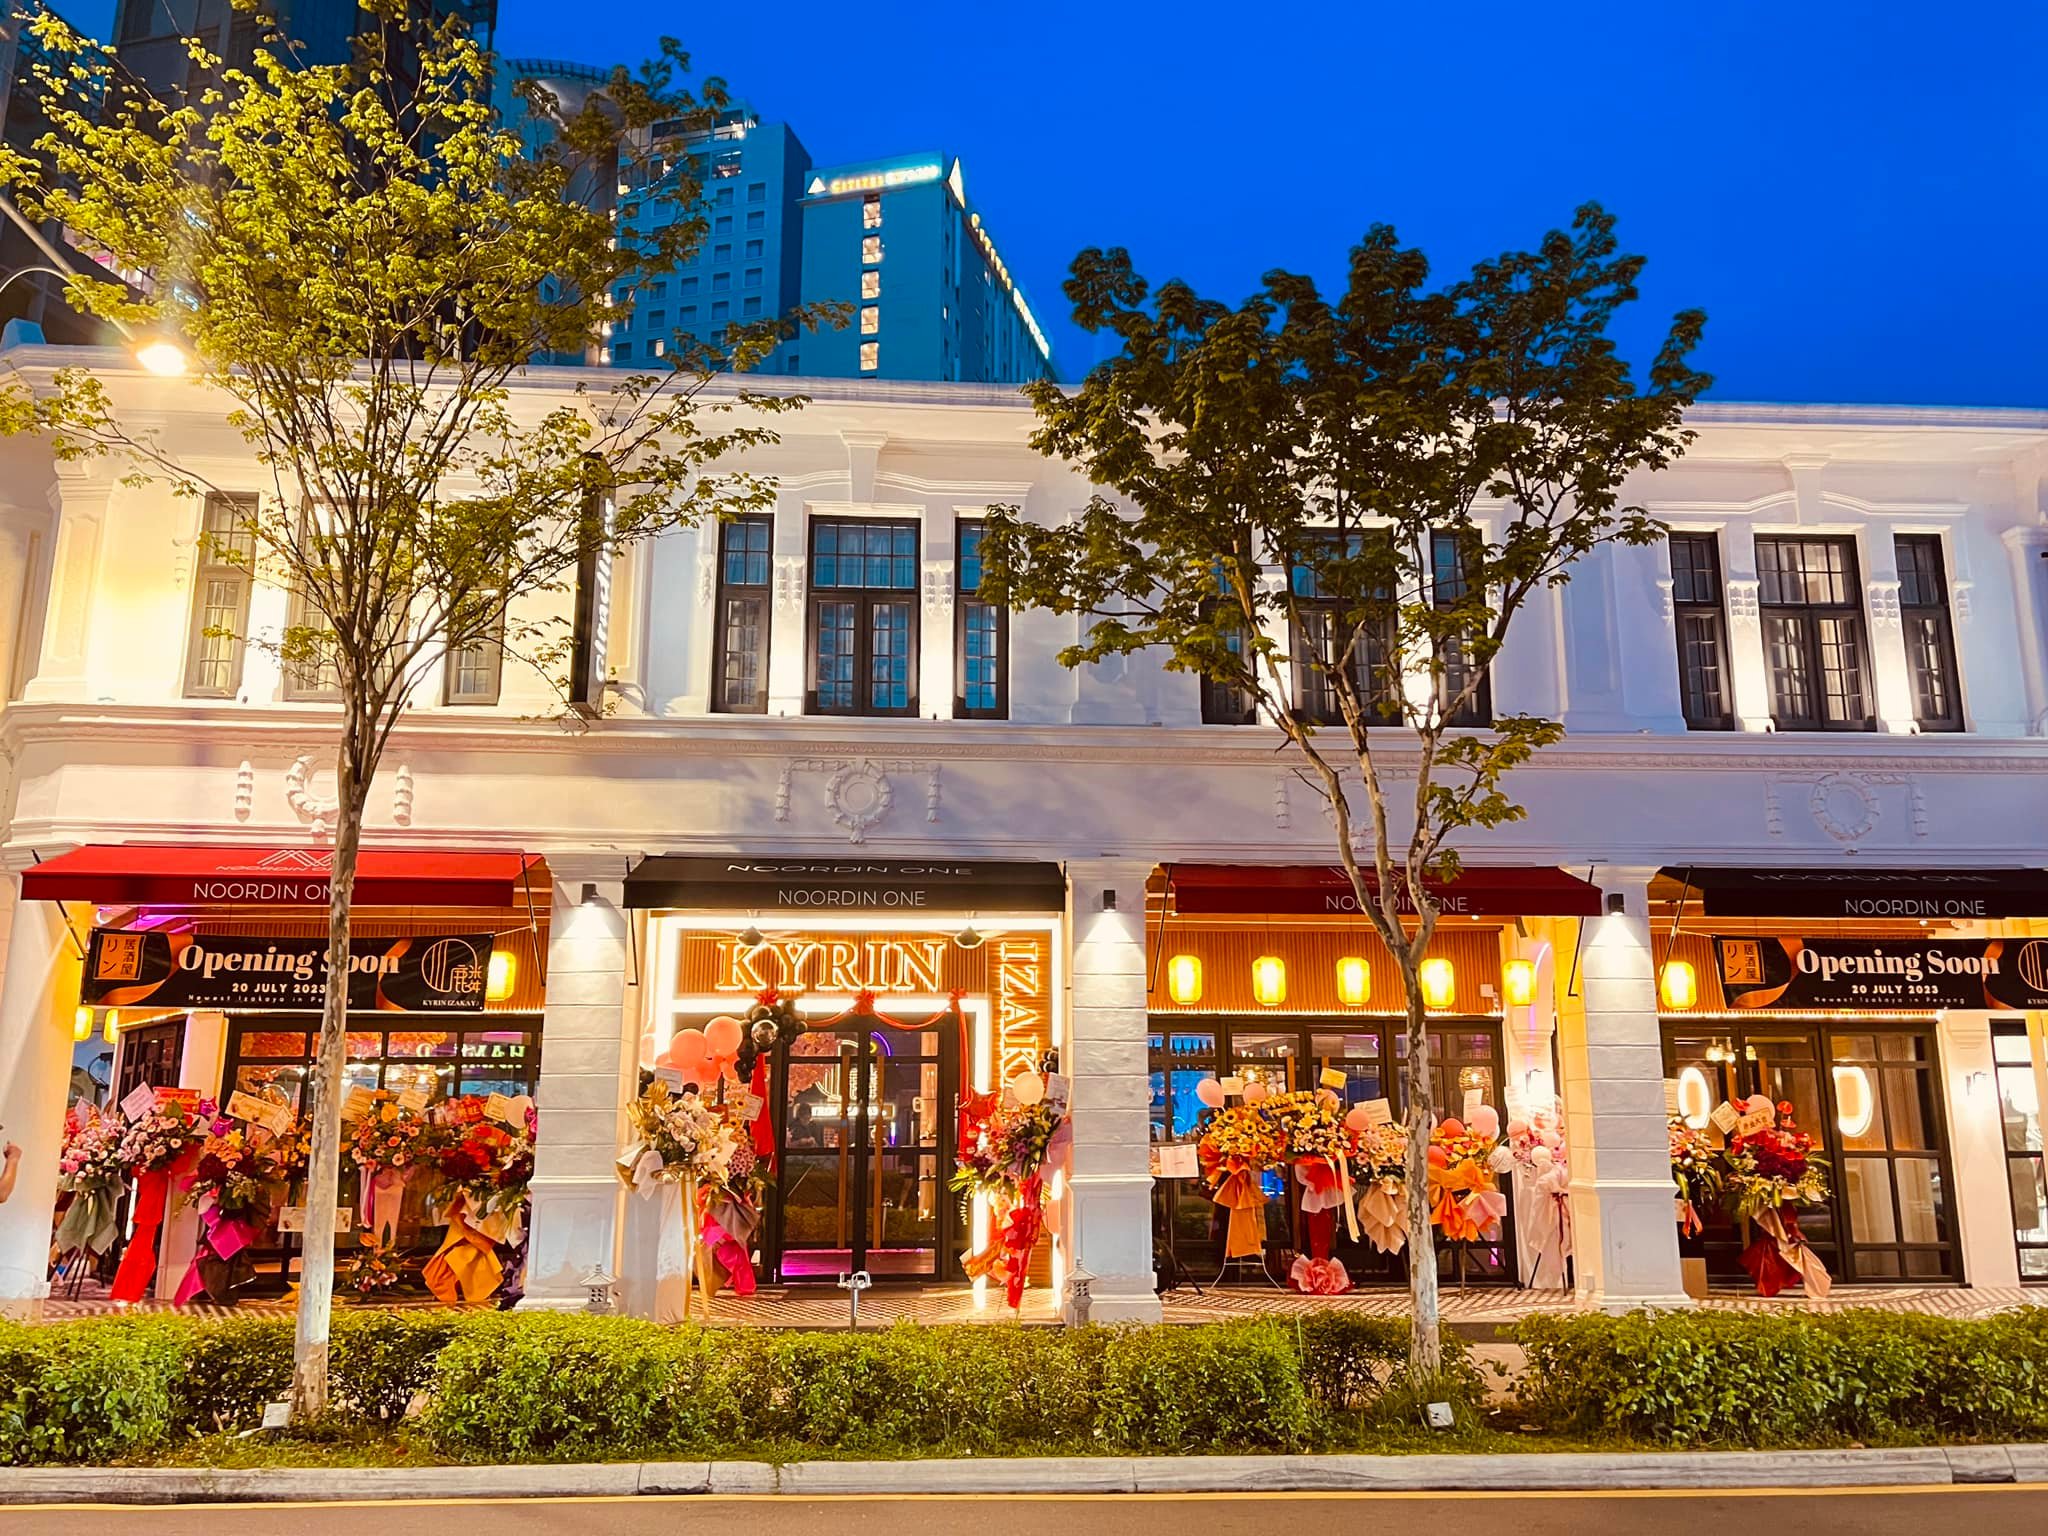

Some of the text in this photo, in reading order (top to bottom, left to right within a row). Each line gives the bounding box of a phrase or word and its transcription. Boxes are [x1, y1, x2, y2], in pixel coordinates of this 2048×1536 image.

[727, 865, 973, 875] NOORDIN ONE
[193, 882, 331, 900] NOORDIN ON
[778, 890, 926, 906] NOORDIN ONE
[1845, 899, 1987, 915] NOORDIN ONE
[178, 945, 317, 981] Opening
[715, 940, 948, 992] KYRIN
[1796, 949, 2001, 982] Opening Soon
[231, 983, 326, 994] 20 JULY 2023
[1851, 985, 1939, 994] 20 JULY 2023
